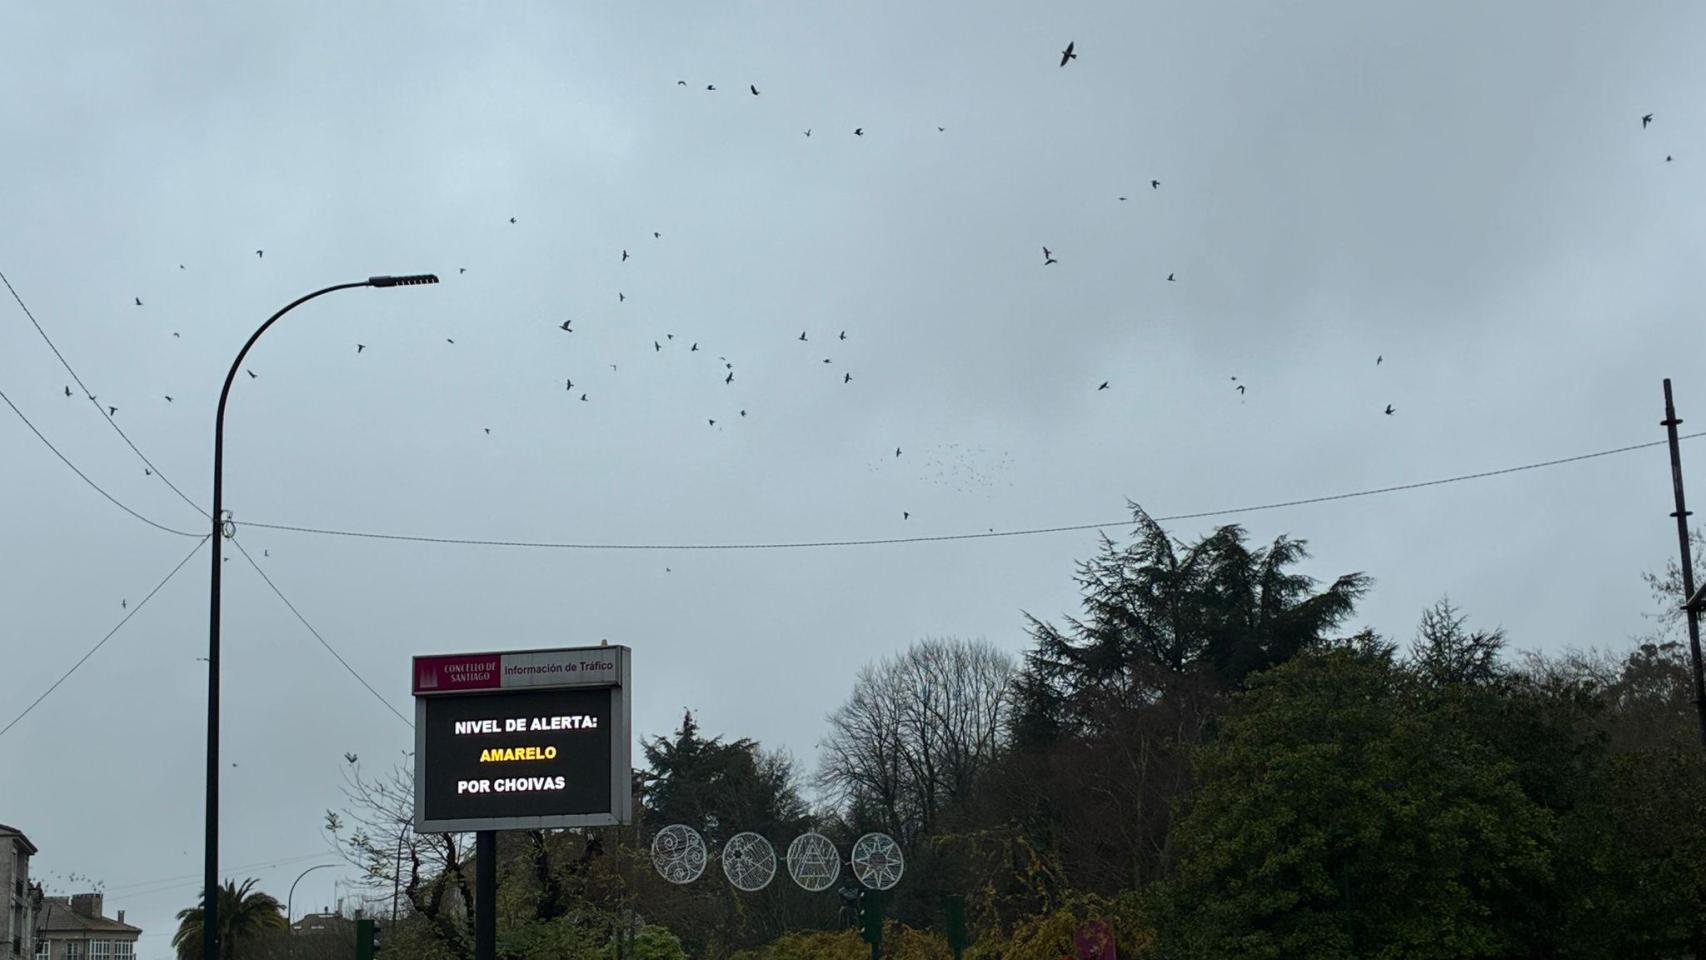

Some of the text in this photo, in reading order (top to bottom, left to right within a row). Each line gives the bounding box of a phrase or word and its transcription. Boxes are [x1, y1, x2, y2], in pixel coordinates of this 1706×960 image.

[444, 662, 496, 673] CONCELLO DE
[505, 660, 614, 675] Información de Tráfico
[451, 673, 490, 682] SANTIAGO
[455, 715, 598, 734] NIVEL DE ALERTA:
[480, 746, 557, 762] AMARELO
[457, 776, 566, 794] POR CHOIVAS
